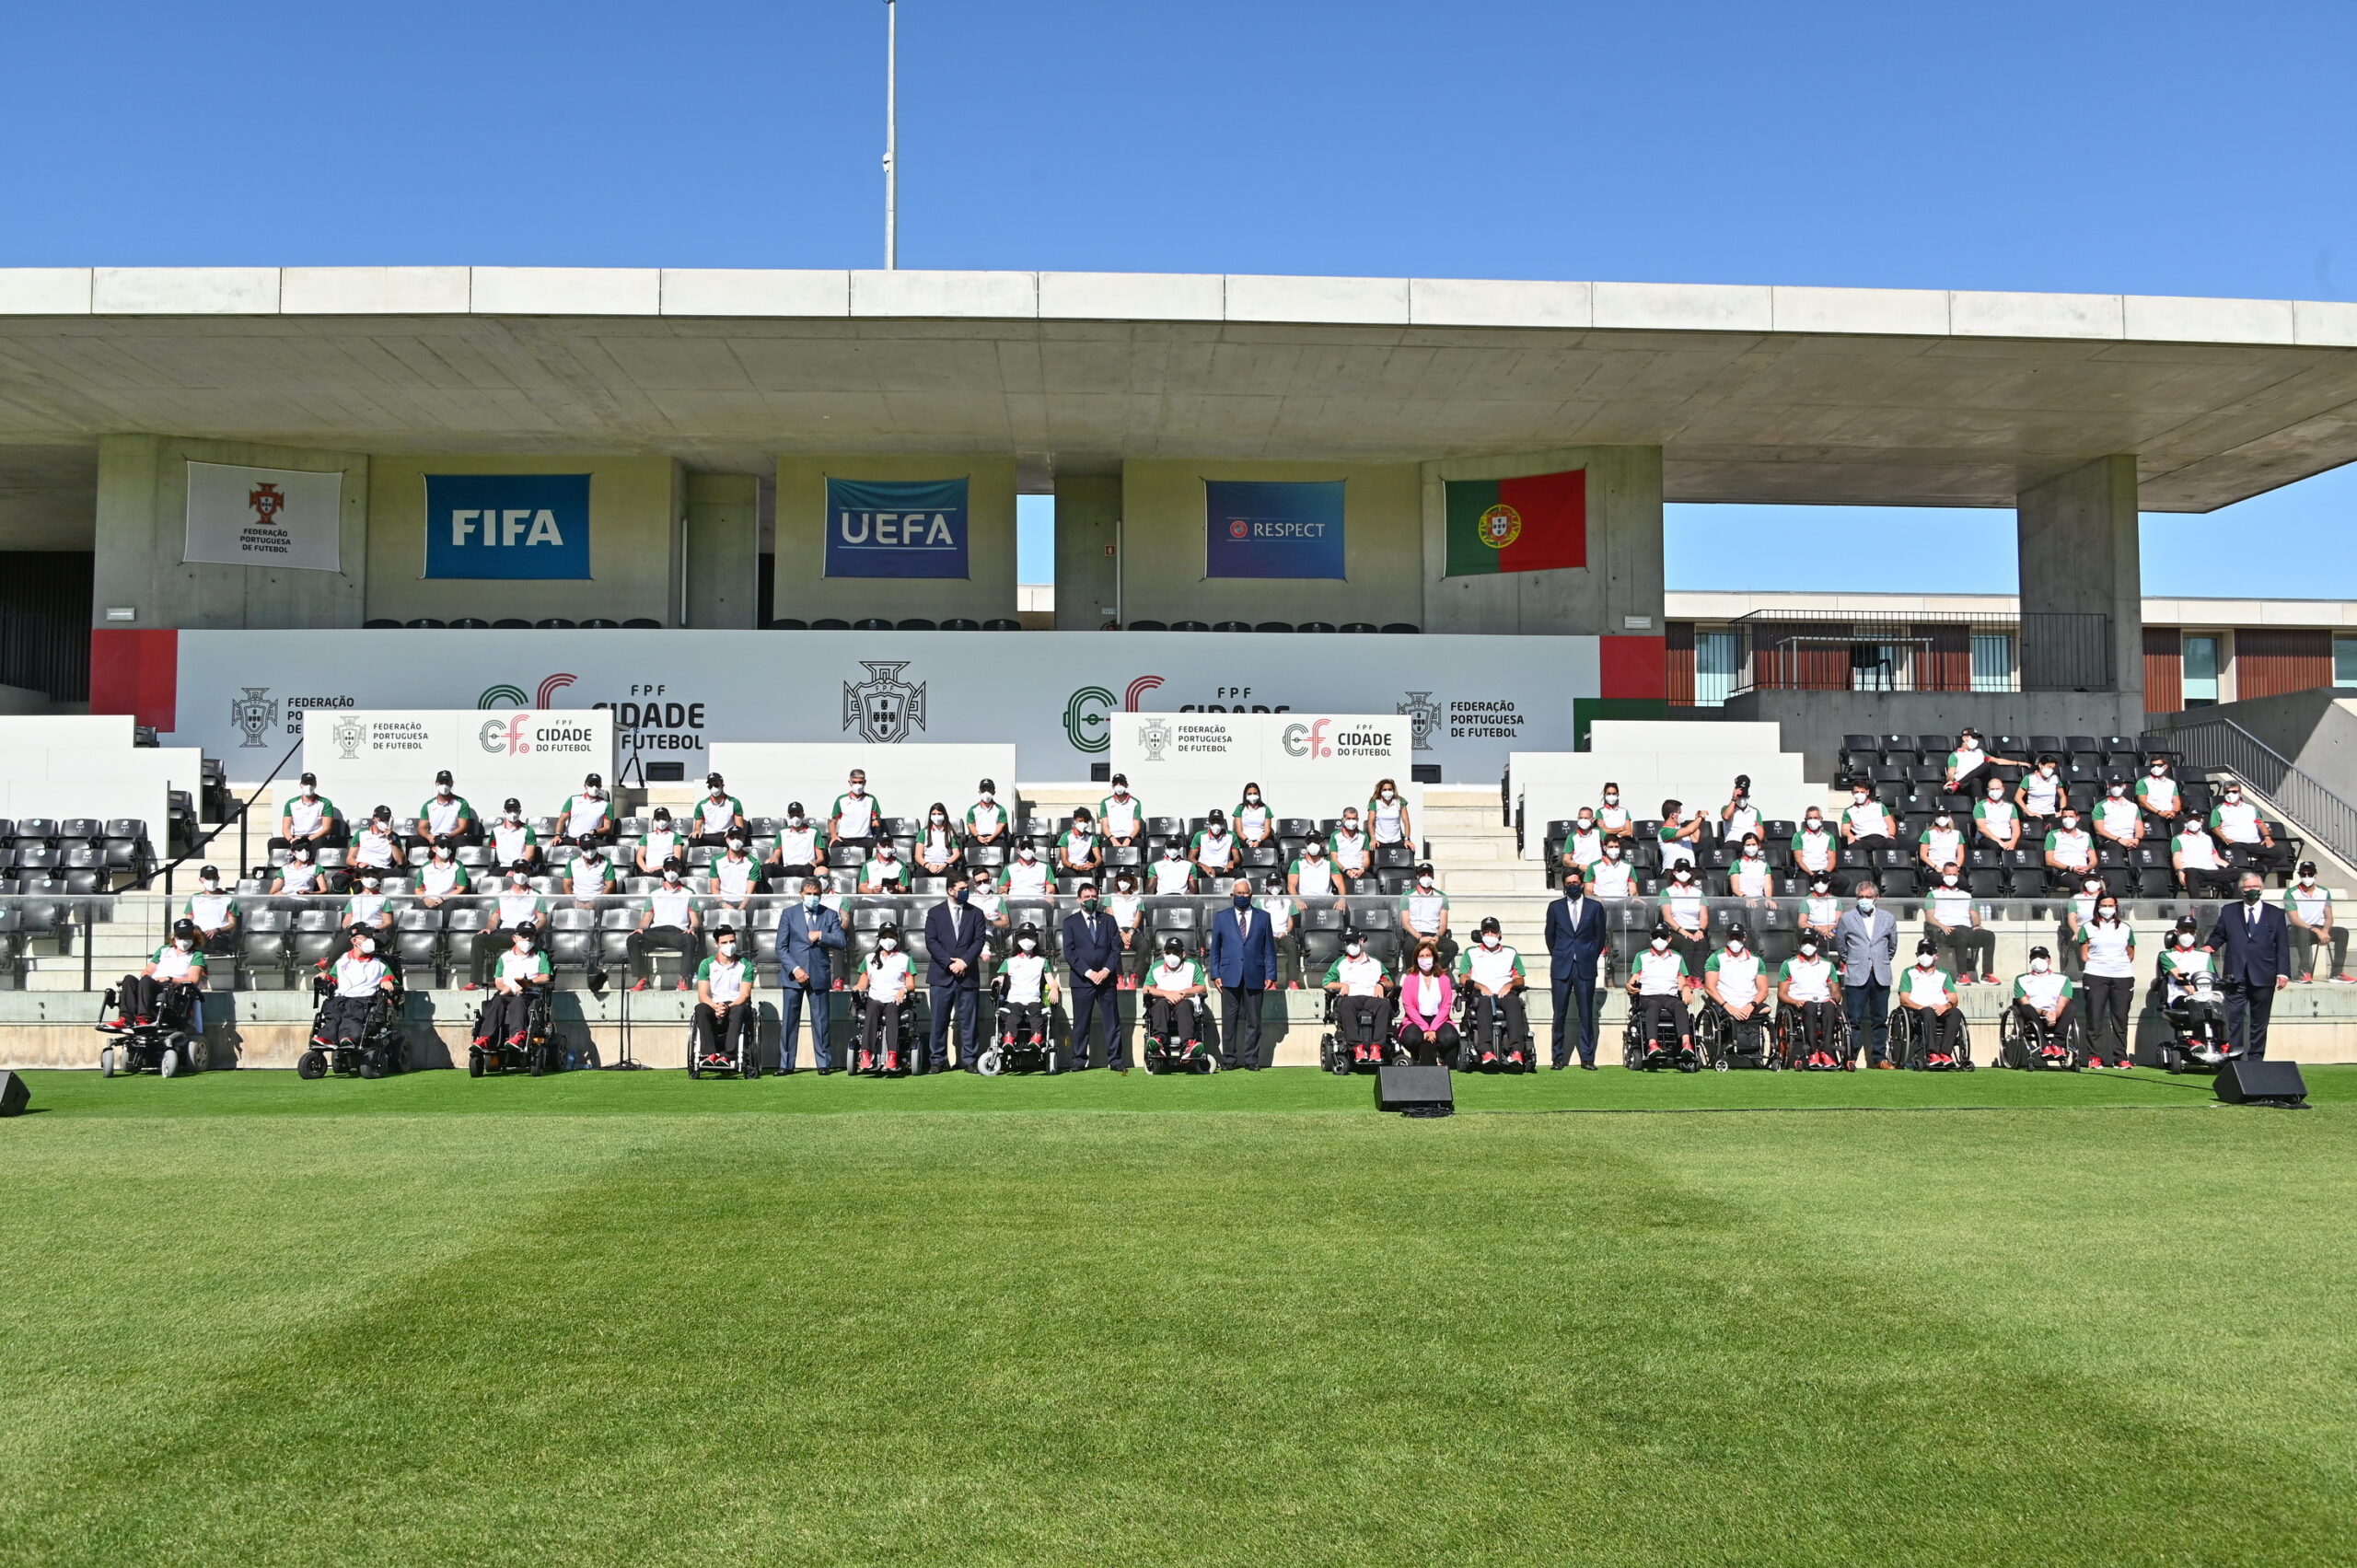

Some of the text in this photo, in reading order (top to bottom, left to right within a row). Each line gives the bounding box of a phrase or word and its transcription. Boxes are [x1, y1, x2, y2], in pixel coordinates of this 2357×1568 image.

[243, 528, 288, 538] FEDERAÇÃO
[452, 509, 563, 546] FIFA
[842, 512, 954, 545] UEFA
[1254, 522, 1326, 538] RESPECT
[239, 535, 292, 546] PORTUGUESA
[242, 543, 289, 553] DE FUTEBOL
[287, 695, 354, 709] FEDERAÇÃO
[1450, 700, 1515, 713] FEDERAÇÃO
[1450, 714, 1525, 725] PORTUGUESA
[286, 724, 303, 735] DE
[373, 721, 423, 731] FEDERAÇÃO
[1178, 724, 1226, 735] FEDERAÇÃO
[373, 732, 429, 740] PORTUGUESA
[536, 728, 592, 741] CIDADE
[1450, 727, 1517, 738] DE FUTEBOL
[621, 734, 704, 750] FUTEBOL
[1178, 735, 1233, 743] PORTUGUESA
[1338, 733, 1392, 746] CIDADE
[536, 744, 592, 752] DO FUTEBOL
[1178, 744, 1227, 752] DE FUTEBOL
[1337, 748, 1392, 757] DO FUTEBOL
